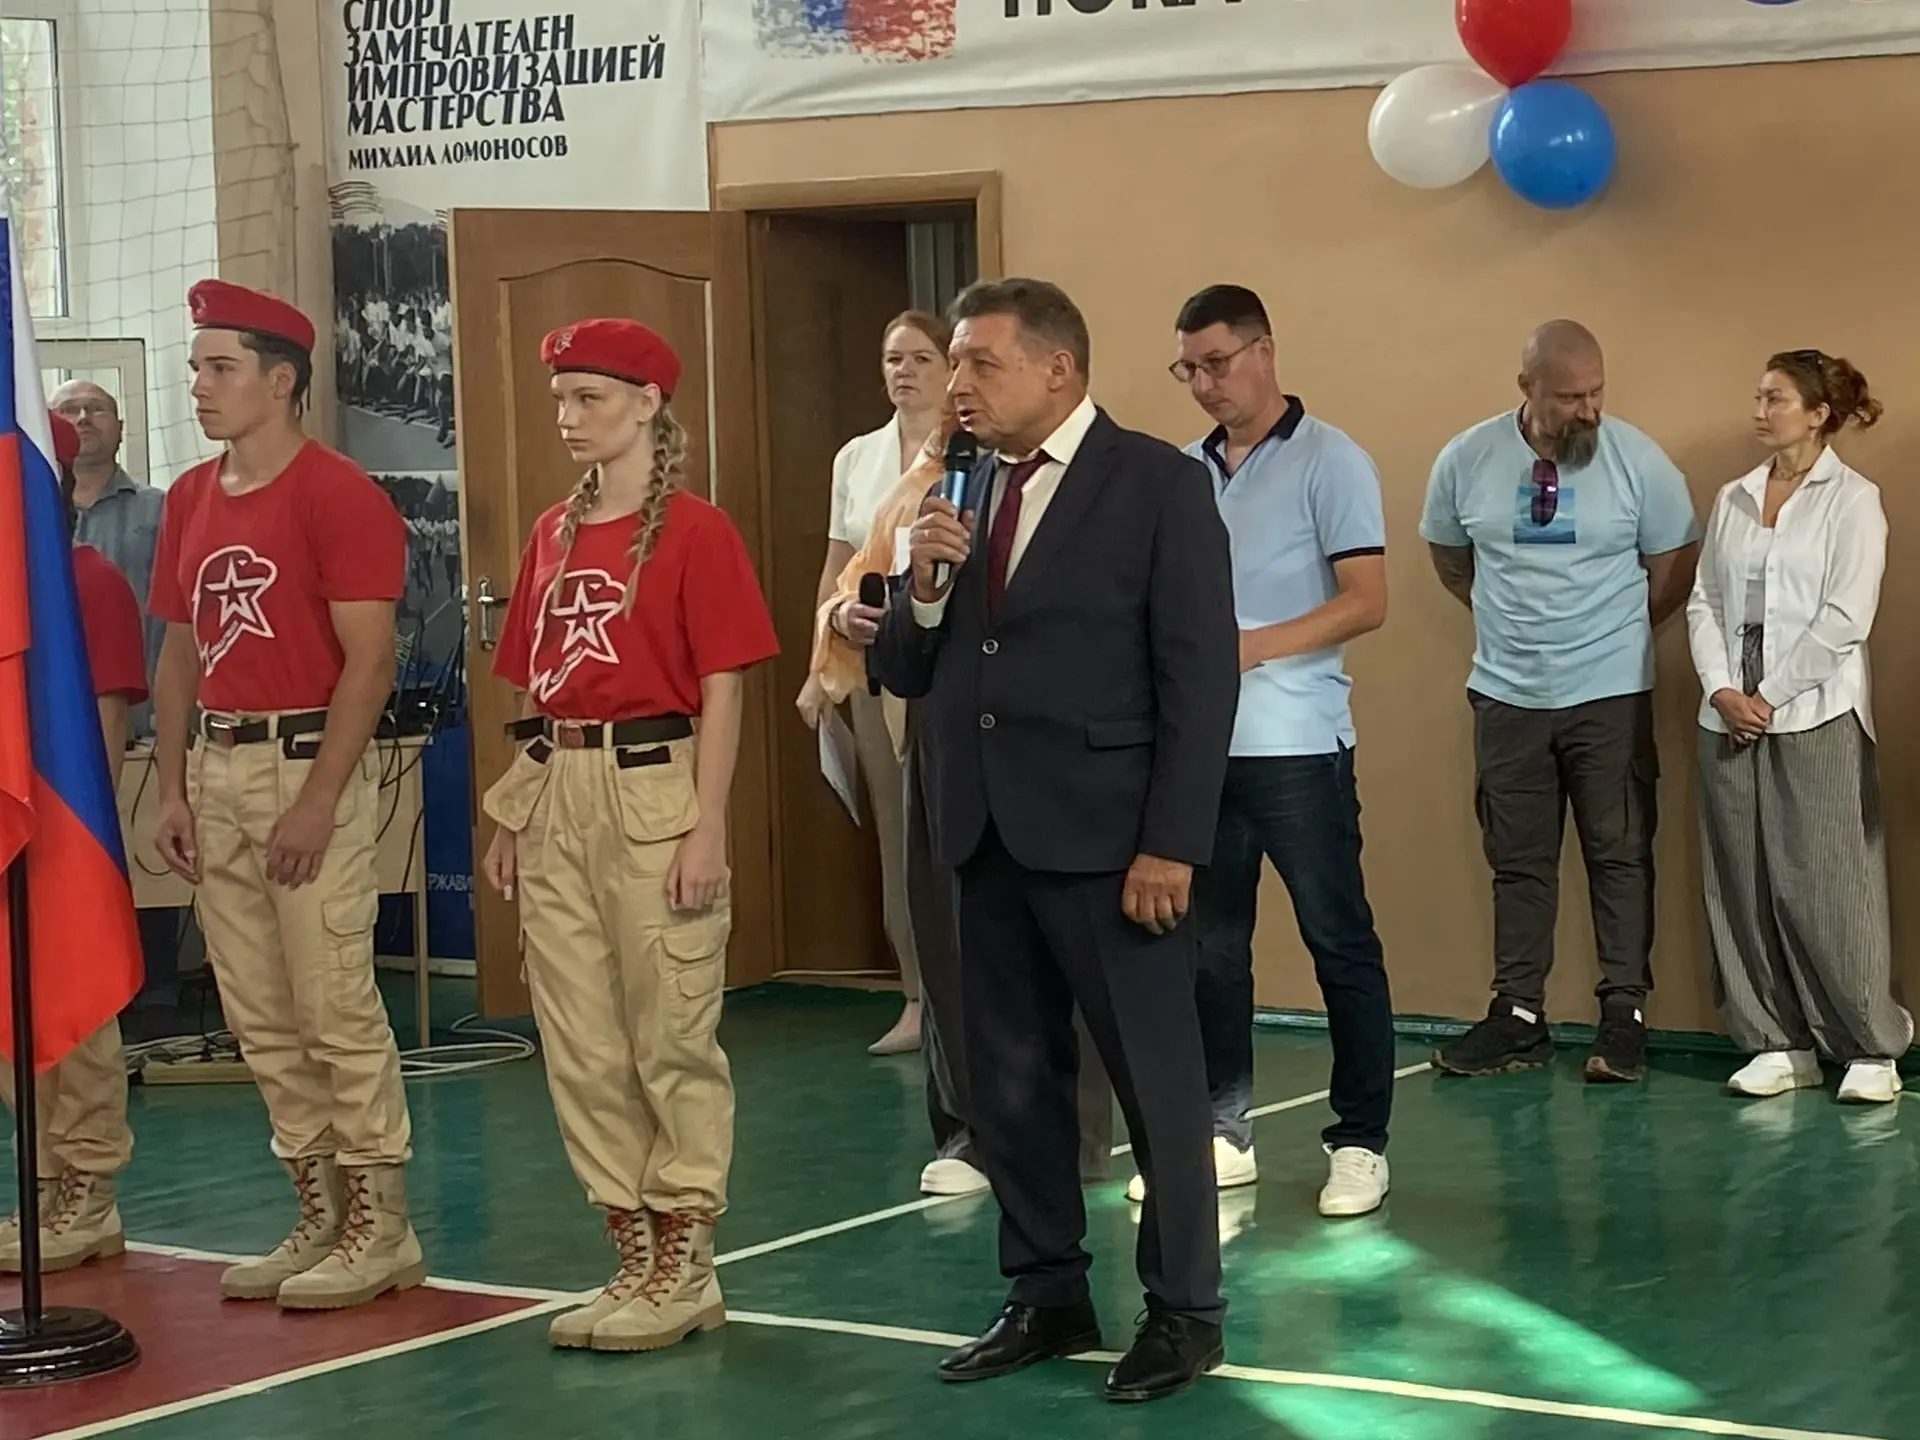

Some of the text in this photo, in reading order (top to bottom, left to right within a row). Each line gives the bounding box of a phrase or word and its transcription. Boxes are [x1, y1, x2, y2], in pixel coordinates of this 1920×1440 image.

[343, 0, 452, 33] СПОРТ
[344, 14, 575, 67] ЗАМЕЧАТЕЛЕН
[347, 34, 666, 102] ИМПРОВИЗАЦИЕЙ
[347, 87, 565, 136] МАСТЕРСТВА
[348, 135, 568, 170] МИХАИЛ ЛОМОНОСОВ
